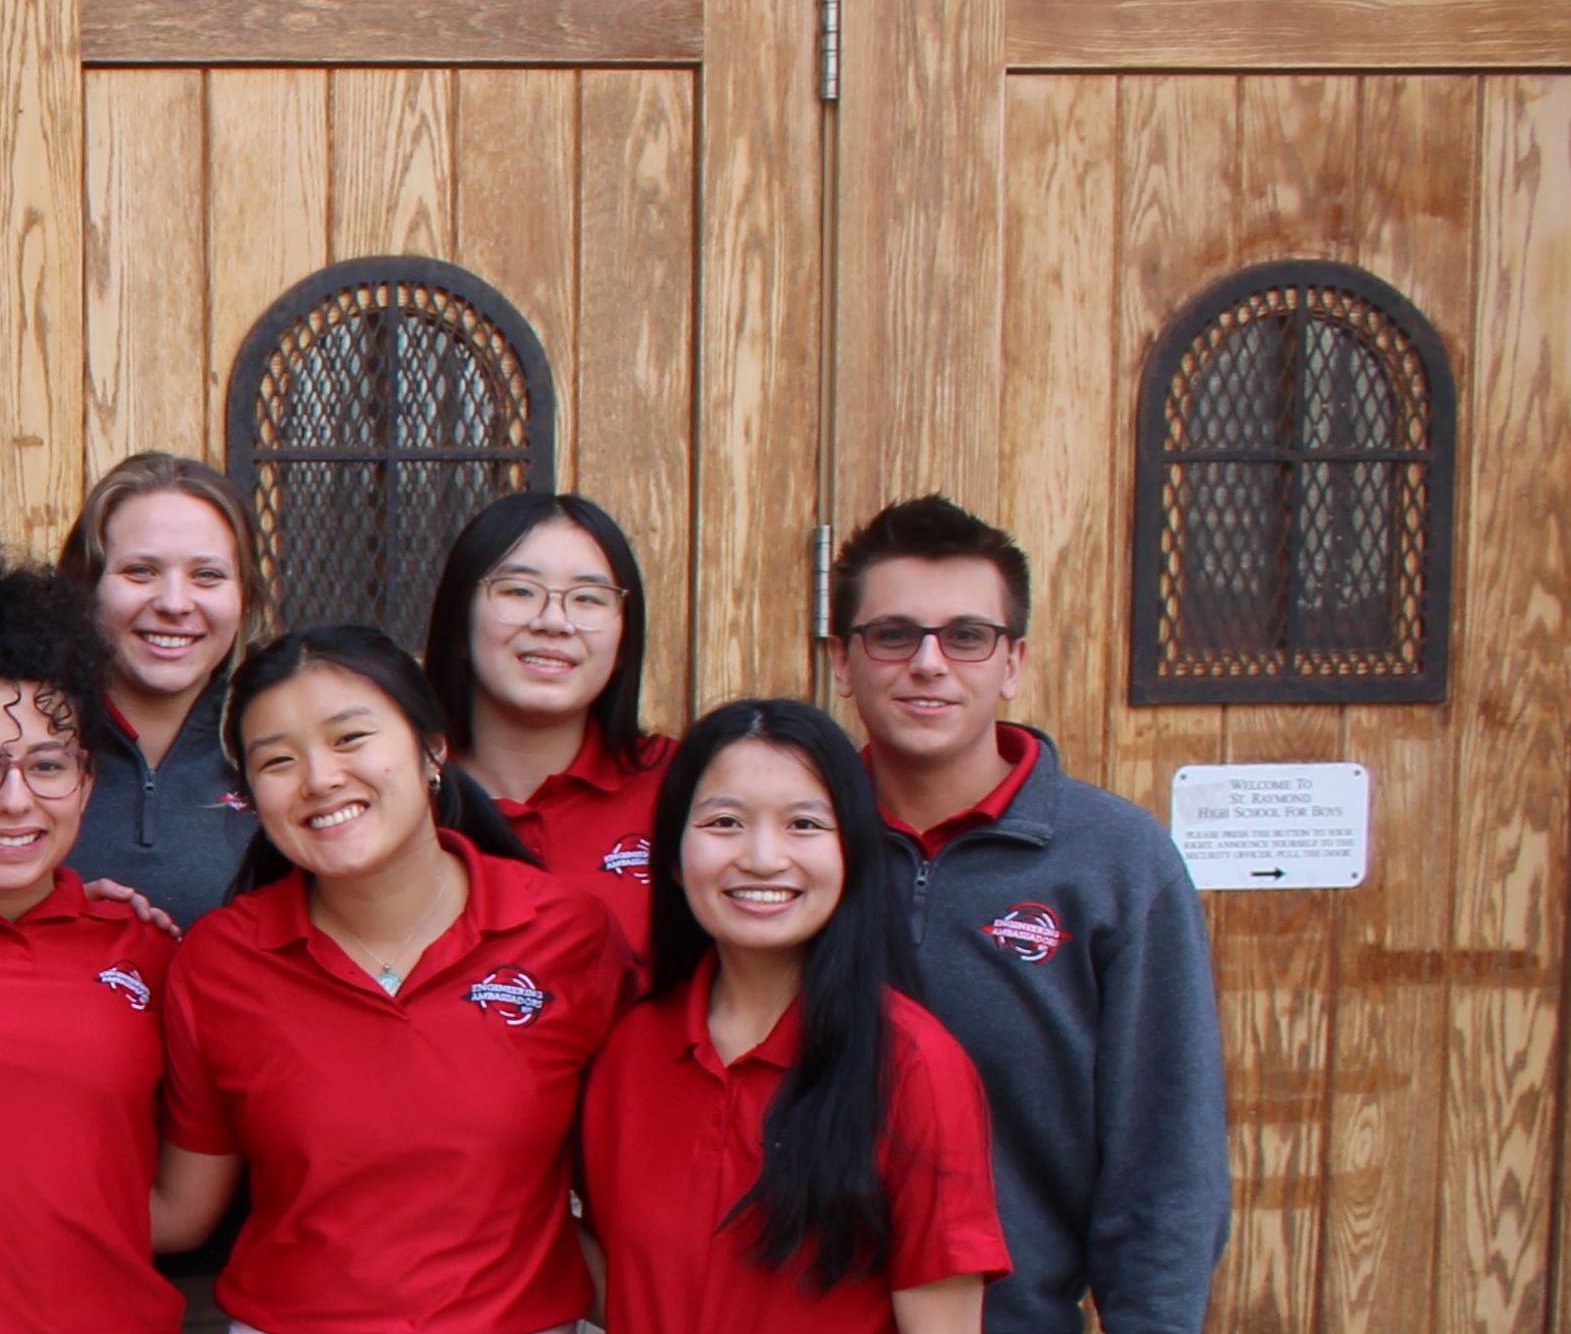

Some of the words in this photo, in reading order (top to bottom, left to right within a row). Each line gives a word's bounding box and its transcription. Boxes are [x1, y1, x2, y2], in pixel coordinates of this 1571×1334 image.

[1198, 807, 1229, 819] HIGH
[1234, 806, 1281, 818] SCHOOL
[1311, 805, 1343, 817] BOYS
